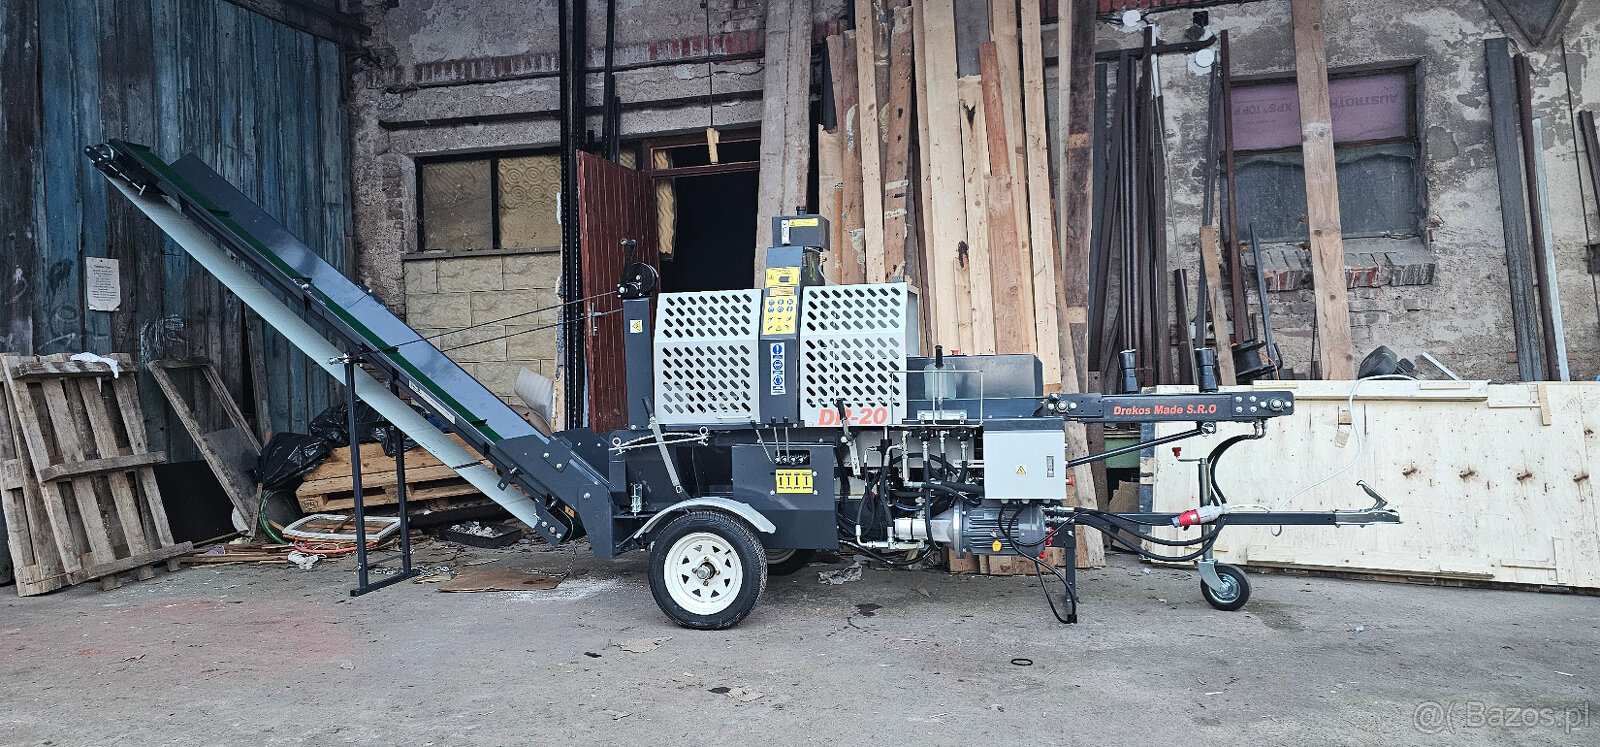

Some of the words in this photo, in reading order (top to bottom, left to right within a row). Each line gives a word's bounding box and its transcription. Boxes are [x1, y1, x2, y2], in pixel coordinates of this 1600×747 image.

[1330, 94, 1399, 109] AUSTROTH
[1113, 405, 1151, 415] Drekos
[1153, 405, 1184, 415] Made
[1186, 404, 1217, 414] S.R.O
